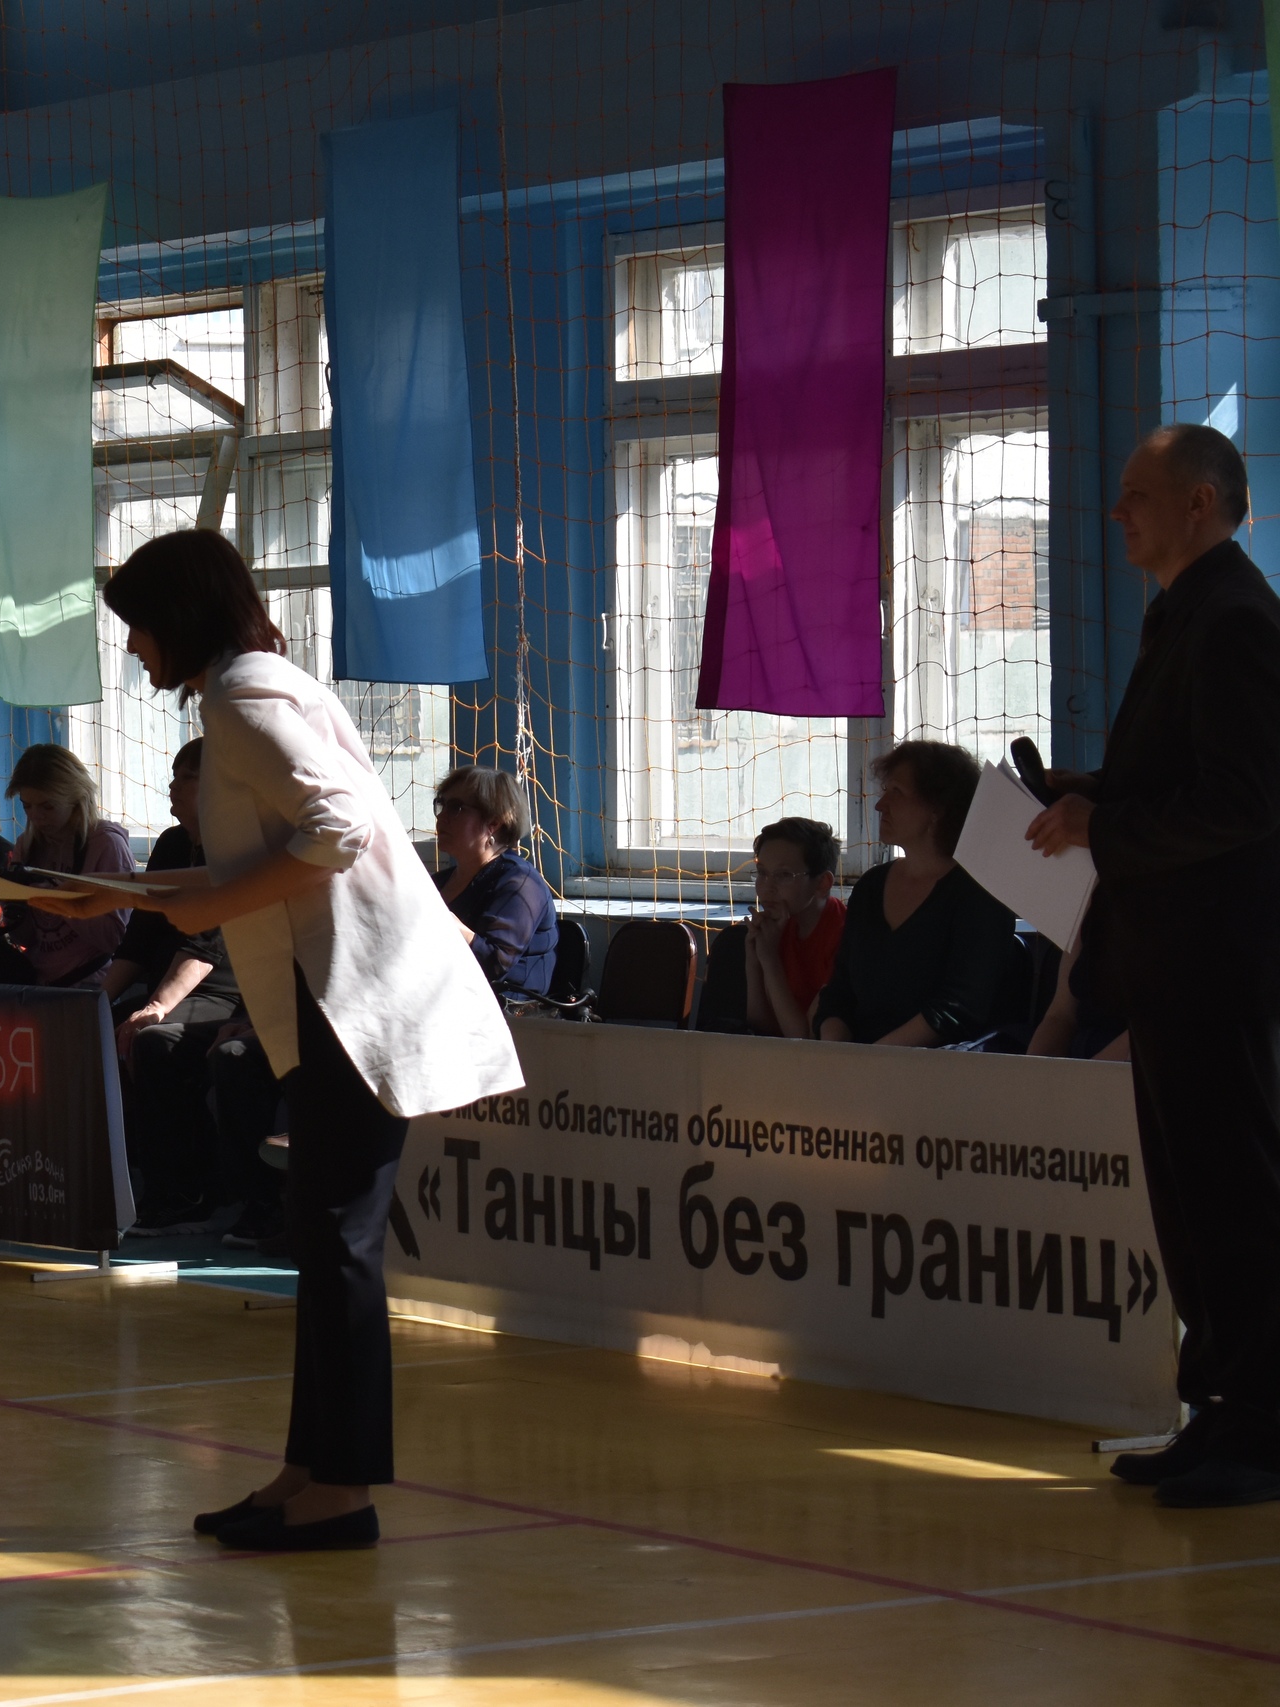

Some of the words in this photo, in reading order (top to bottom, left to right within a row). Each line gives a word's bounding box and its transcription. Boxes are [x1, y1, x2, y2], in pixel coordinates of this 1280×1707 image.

[439, 1095, 530, 1127] ская
[537, 1089, 679, 1144] областная
[687, 1104, 905, 1166] общественная
[915, 1135, 1131, 1192] организация
[418, 1136, 651, 1271] «Танцы
[679, 1160, 809, 1282] без
[835, 1209, 1158, 1343] границ»
